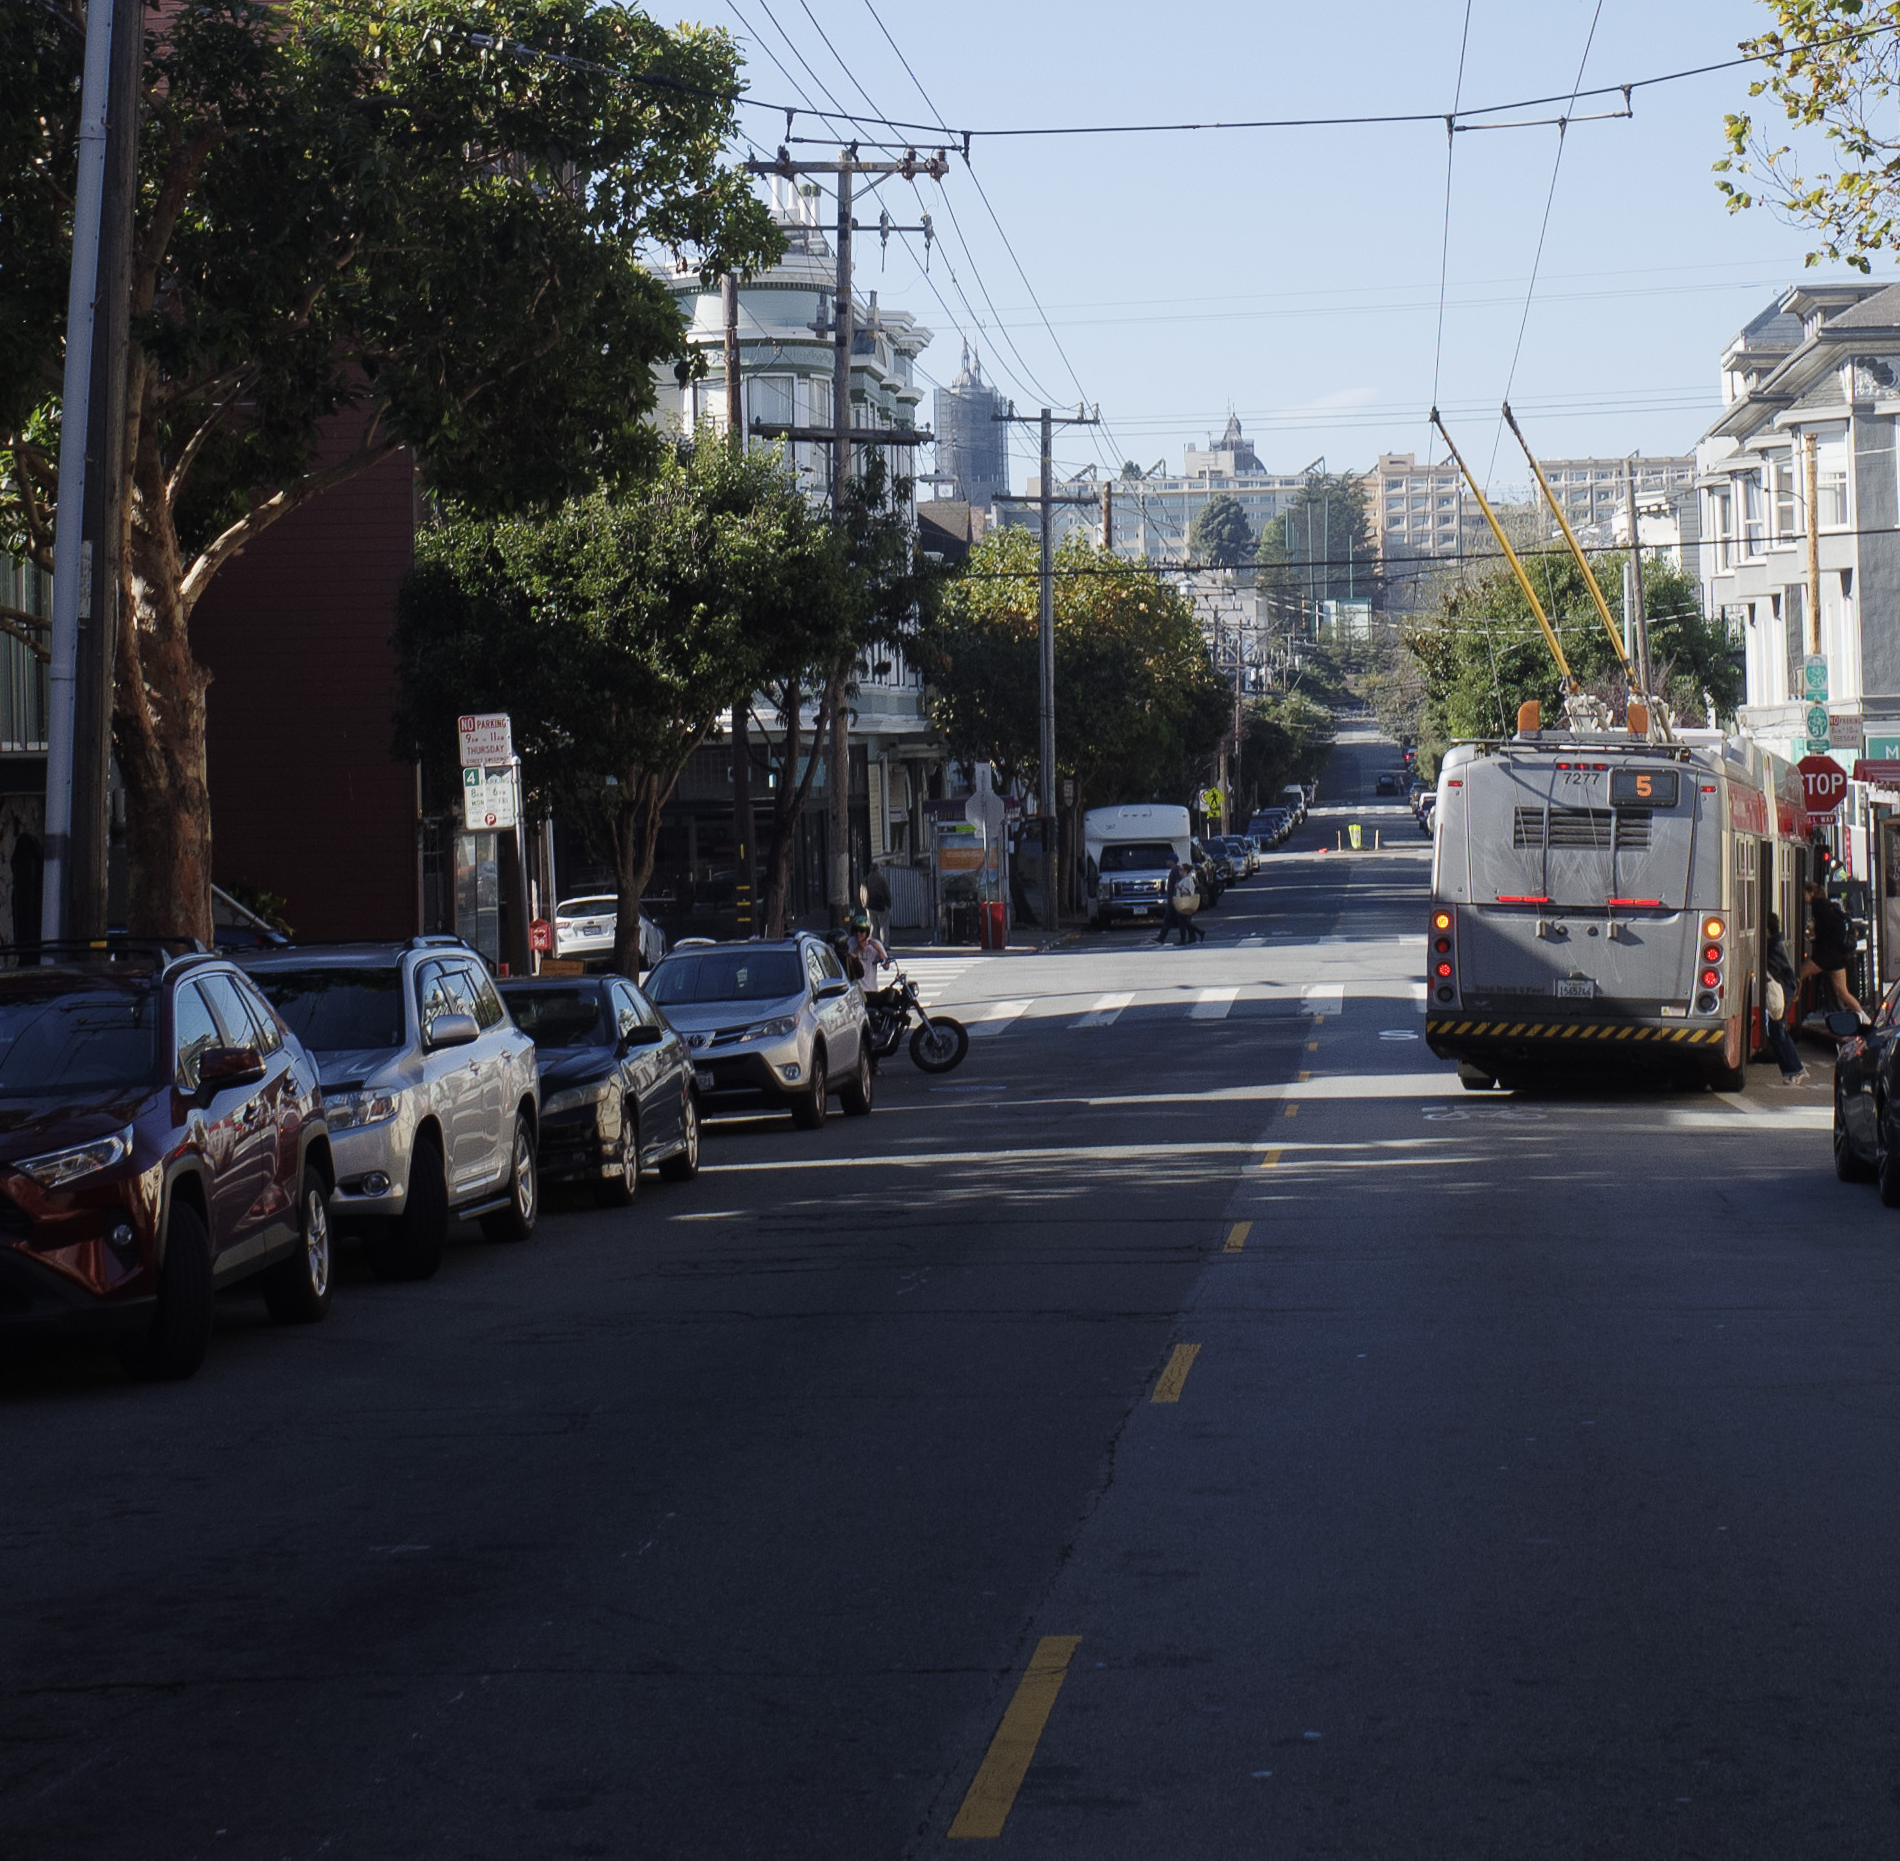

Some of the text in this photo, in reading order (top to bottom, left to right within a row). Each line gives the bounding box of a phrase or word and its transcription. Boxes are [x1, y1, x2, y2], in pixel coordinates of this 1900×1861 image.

[1811, 677, 1824, 687] 20
[461, 718, 506, 731] NO PARKING
[1812, 726, 1824, 736] 51
[467, 745, 504, 755] THURSDAY
[467, 771, 475, 785] 4
[1563, 772, 1600, 785] 7277
[1804, 772, 1844, 795] TOP
[1636, 775, 1652, 797] 5
[1820, 816, 1835, 824] WAY
